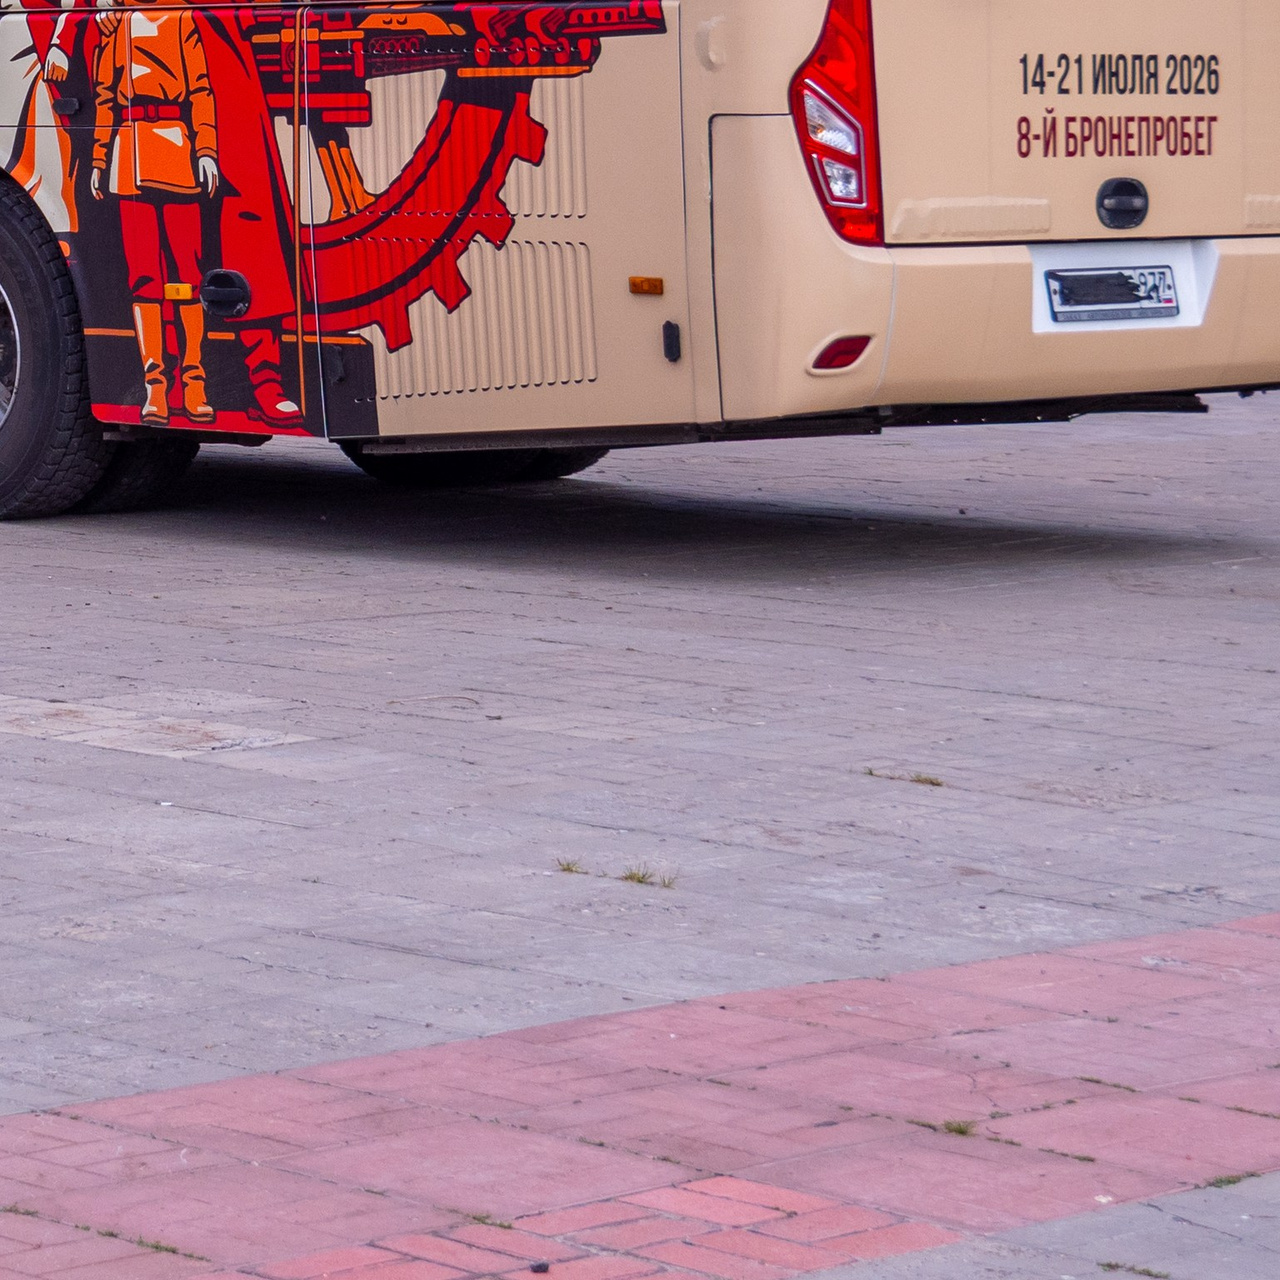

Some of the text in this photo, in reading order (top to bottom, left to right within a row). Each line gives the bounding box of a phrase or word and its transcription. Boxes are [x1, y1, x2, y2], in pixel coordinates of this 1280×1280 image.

[1019, 54, 1220, 95] 14-21 ИЮЛЯ 2026
[1017, 107, 1218, 158] 8-Й БРОНЕПРОБЕГ
